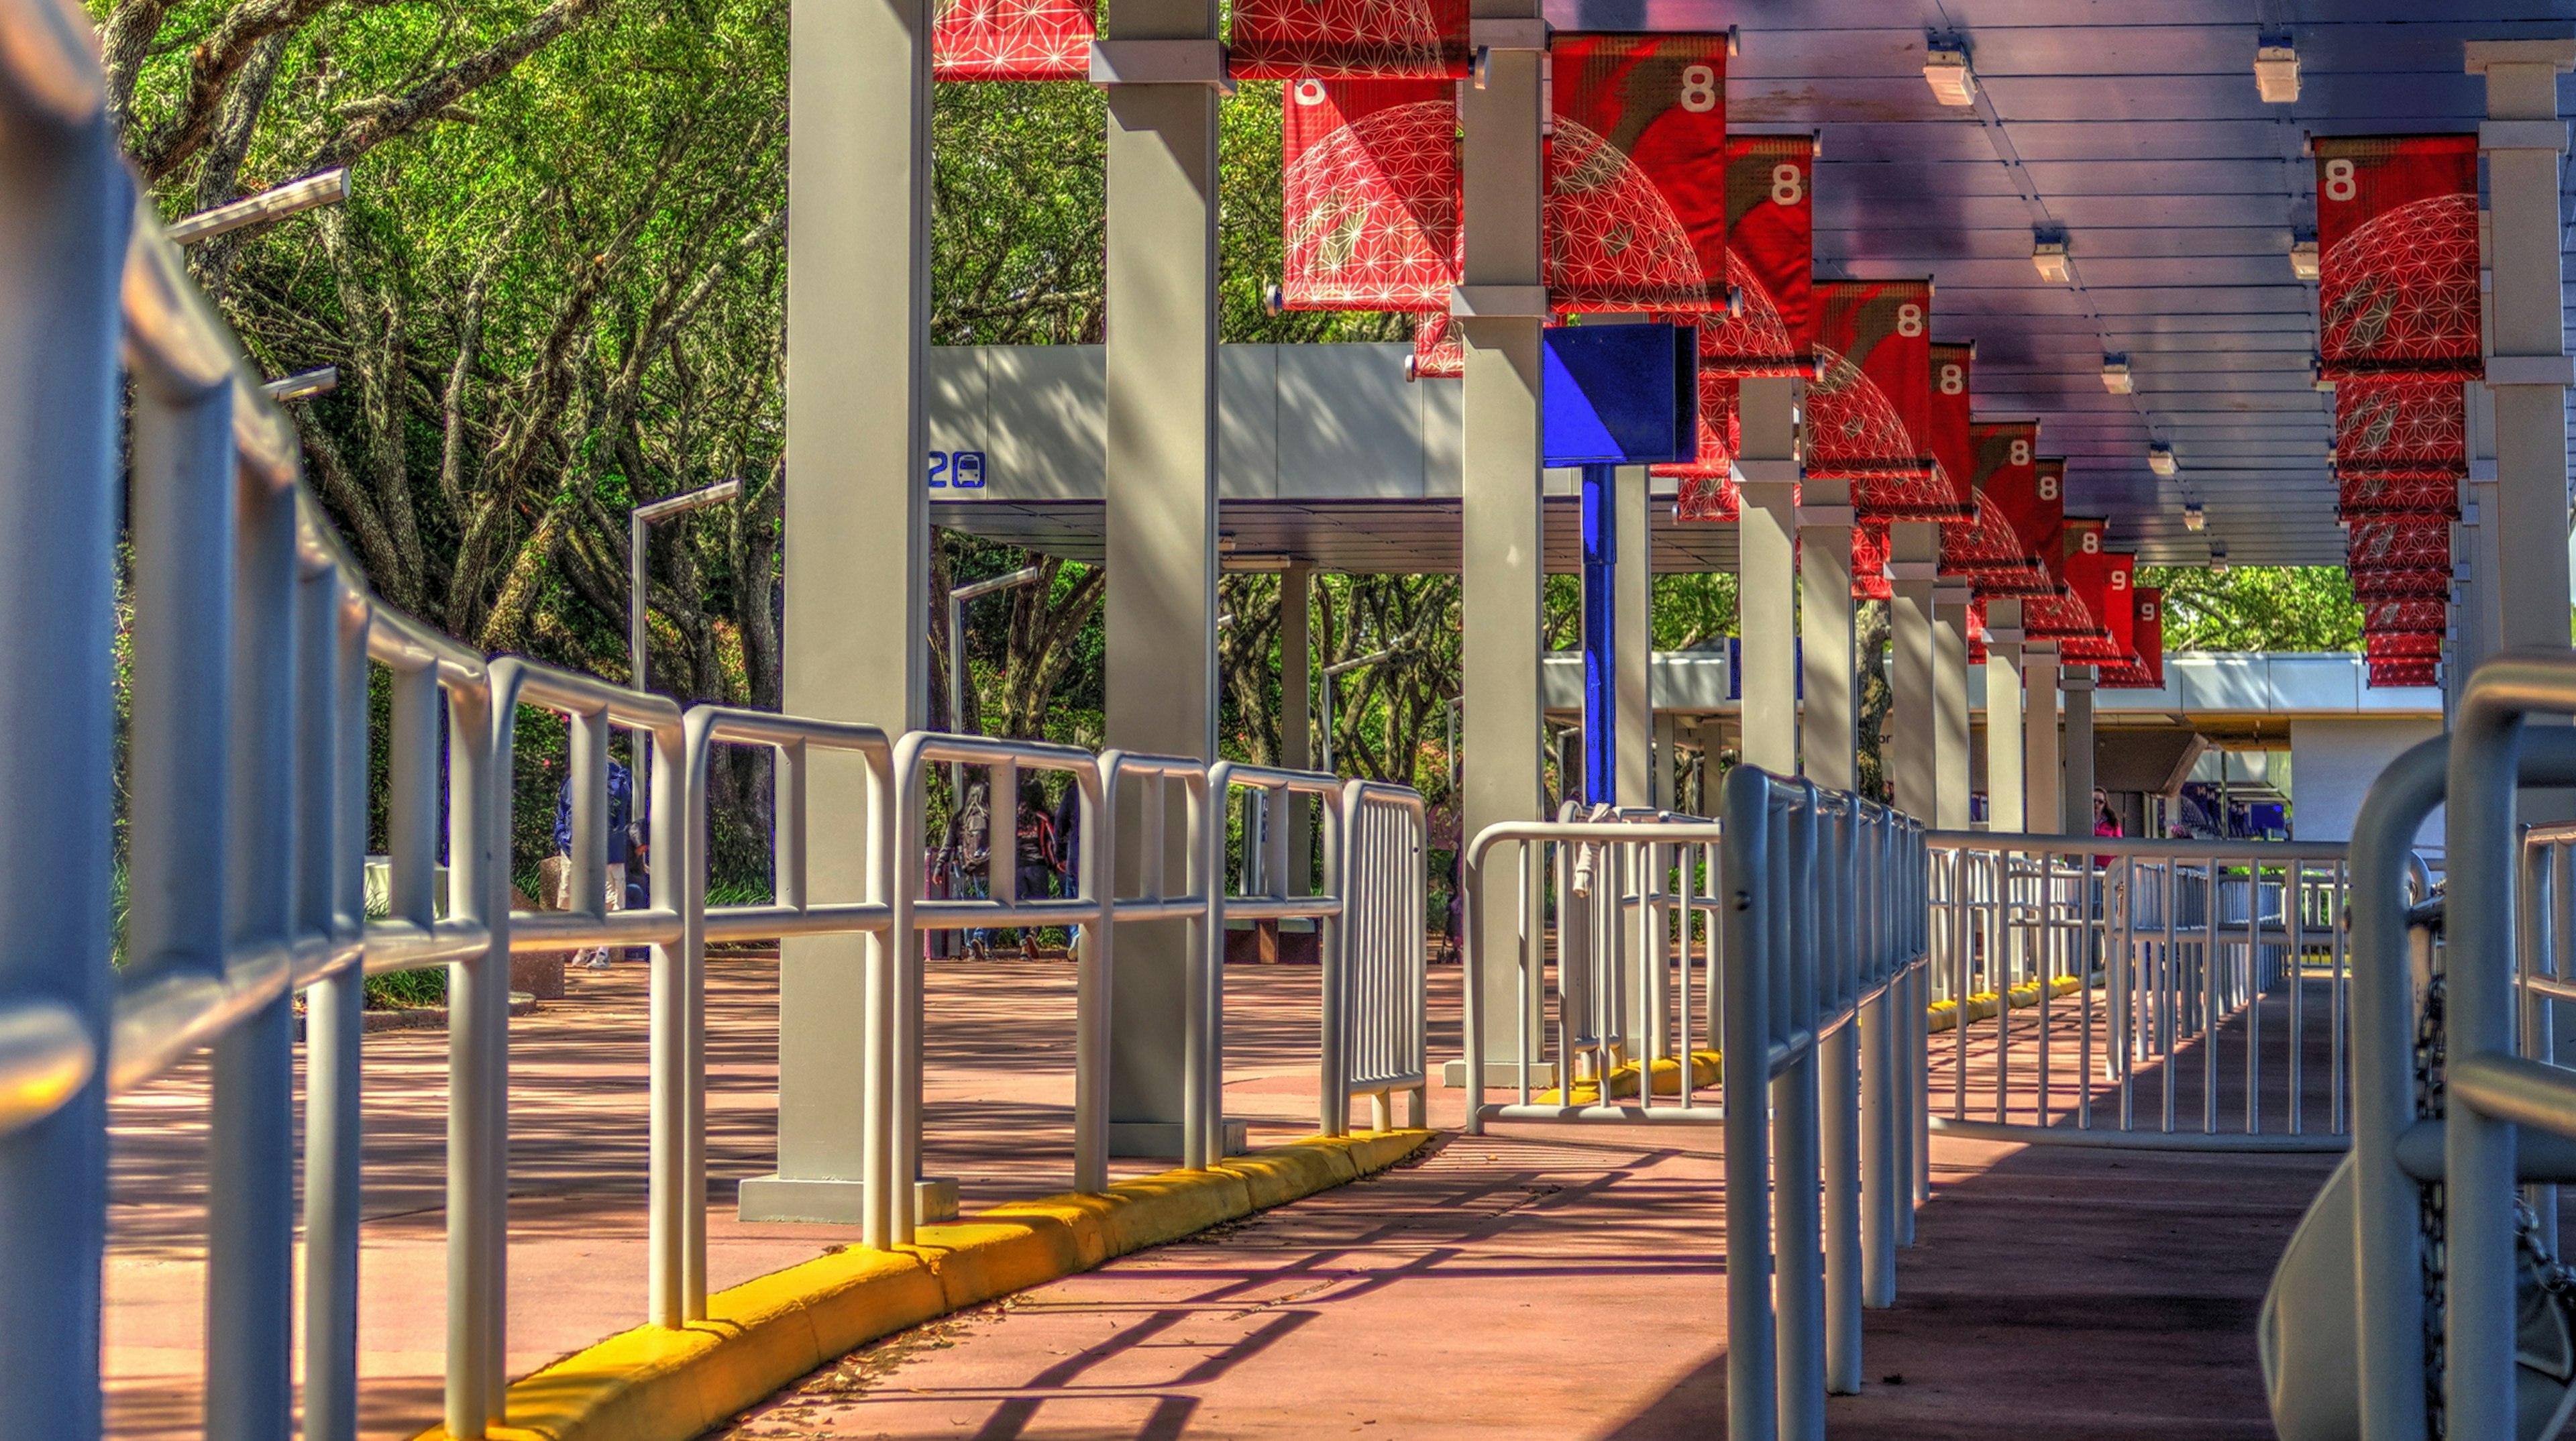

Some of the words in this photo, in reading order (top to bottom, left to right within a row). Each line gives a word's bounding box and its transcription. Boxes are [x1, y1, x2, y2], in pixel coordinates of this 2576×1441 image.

[1680, 66, 1715, 112] 8
[1772, 164, 1802, 205] 8
[2326, 159, 2356, 201] 8
[1897, 305, 1922, 337] 8
[1940, 365, 1963, 394] 8
[2010, 440, 2029, 466] 8
[2039, 476, 2057, 500] 8
[2082, 533, 2098, 553] 8
[2112, 571, 2126, 590] 9
[2142, 603, 2155, 621] 9
